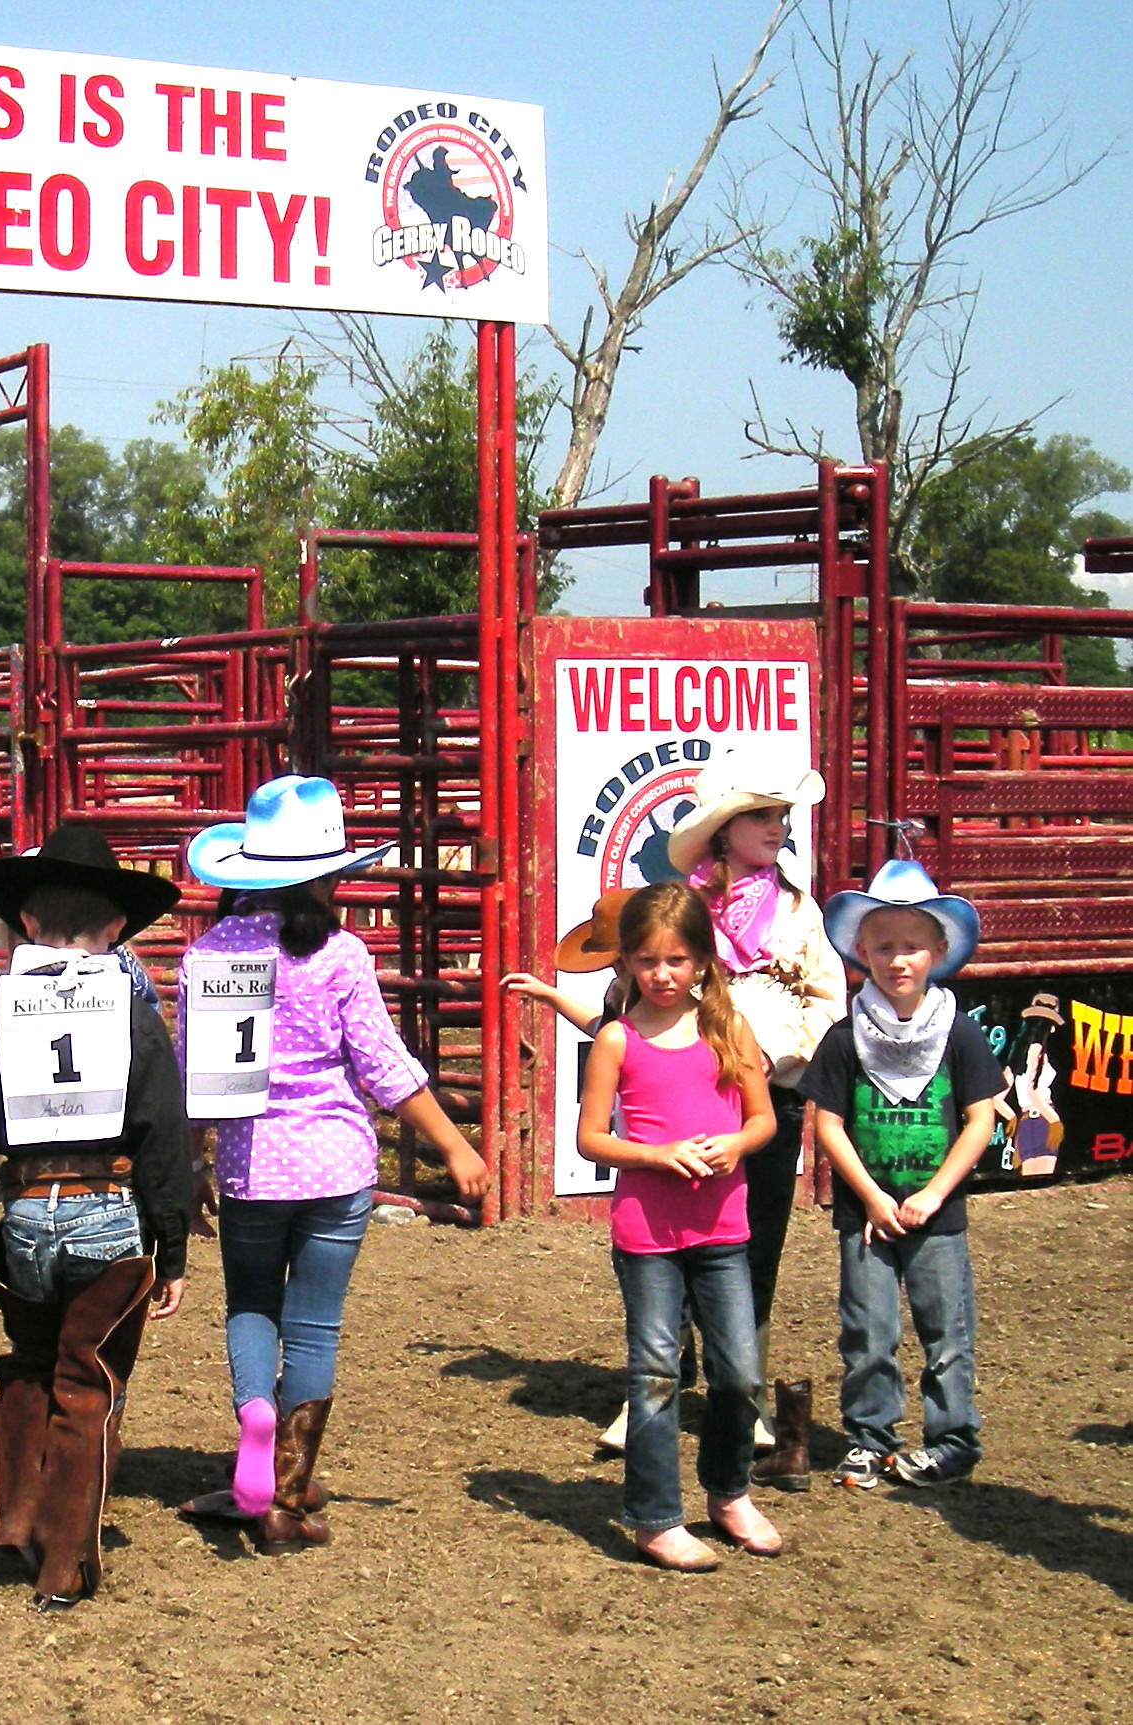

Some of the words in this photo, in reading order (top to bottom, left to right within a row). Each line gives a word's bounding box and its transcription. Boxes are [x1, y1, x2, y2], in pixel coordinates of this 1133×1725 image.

[59, 74, 124, 148] IS
[155, 83, 287, 162] THE
[364, 101, 458, 183] RODEO
[468, 111, 528, 193] CITY
[125, 180, 331, 286] CITY!
[372, 222, 448, 267] GERRY
[451, 215, 526, 275] RODEO
[568, 665, 798, 732] WELCOME
[576, 738, 711, 857] RODEO
[629, 776, 684, 819] CONSECUTIVE
[610, 814, 633, 860] OLDEST
[606, 862, 620, 888] THE
[202, 980, 244, 994] Kid's
[230, 964, 268, 972] GERRY
[13, 998, 57, 1013] Kid's
[63, 996, 115, 1010] Rodeo
[51, 1033, 81, 1083] 1
[235, 1016, 256, 1063] 1
